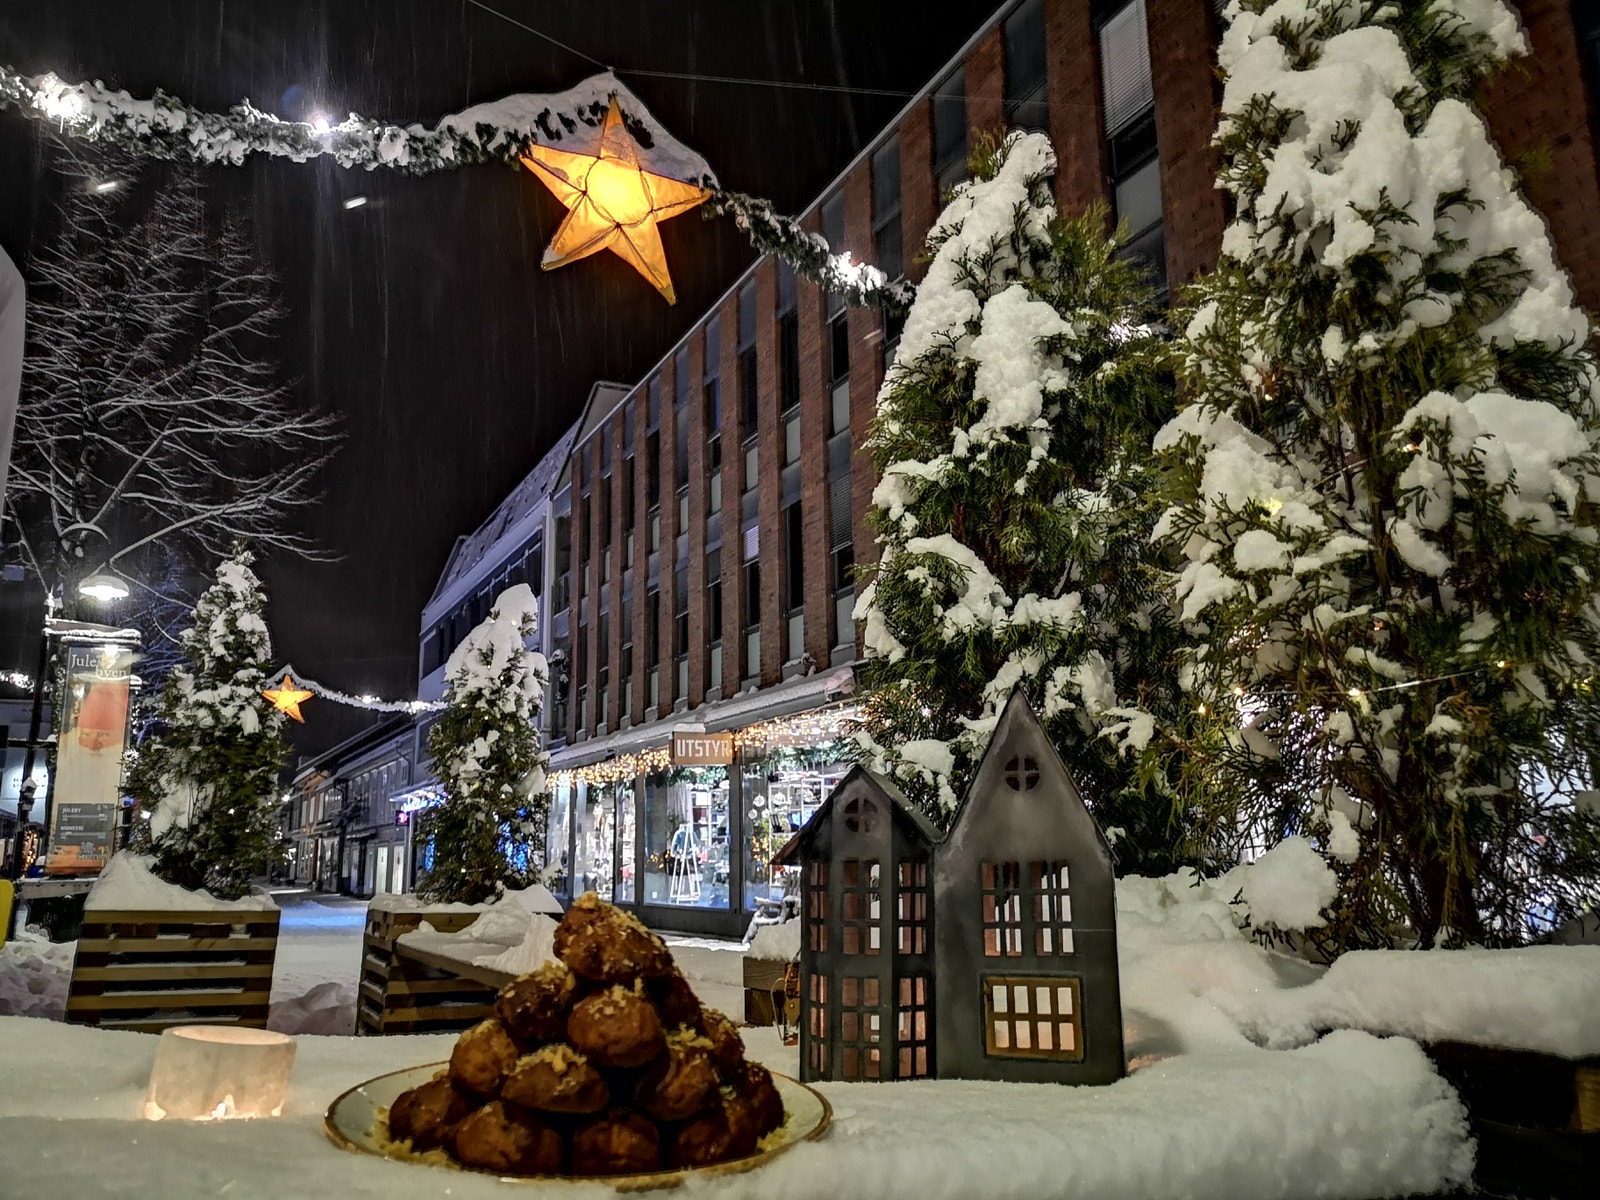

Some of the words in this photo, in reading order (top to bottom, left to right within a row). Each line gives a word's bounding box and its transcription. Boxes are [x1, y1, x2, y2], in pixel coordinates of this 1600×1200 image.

[71, 654, 98, 669] Jule
[95, 665, 127, 680] byen
[676, 739, 730, 758] UTSTYR
